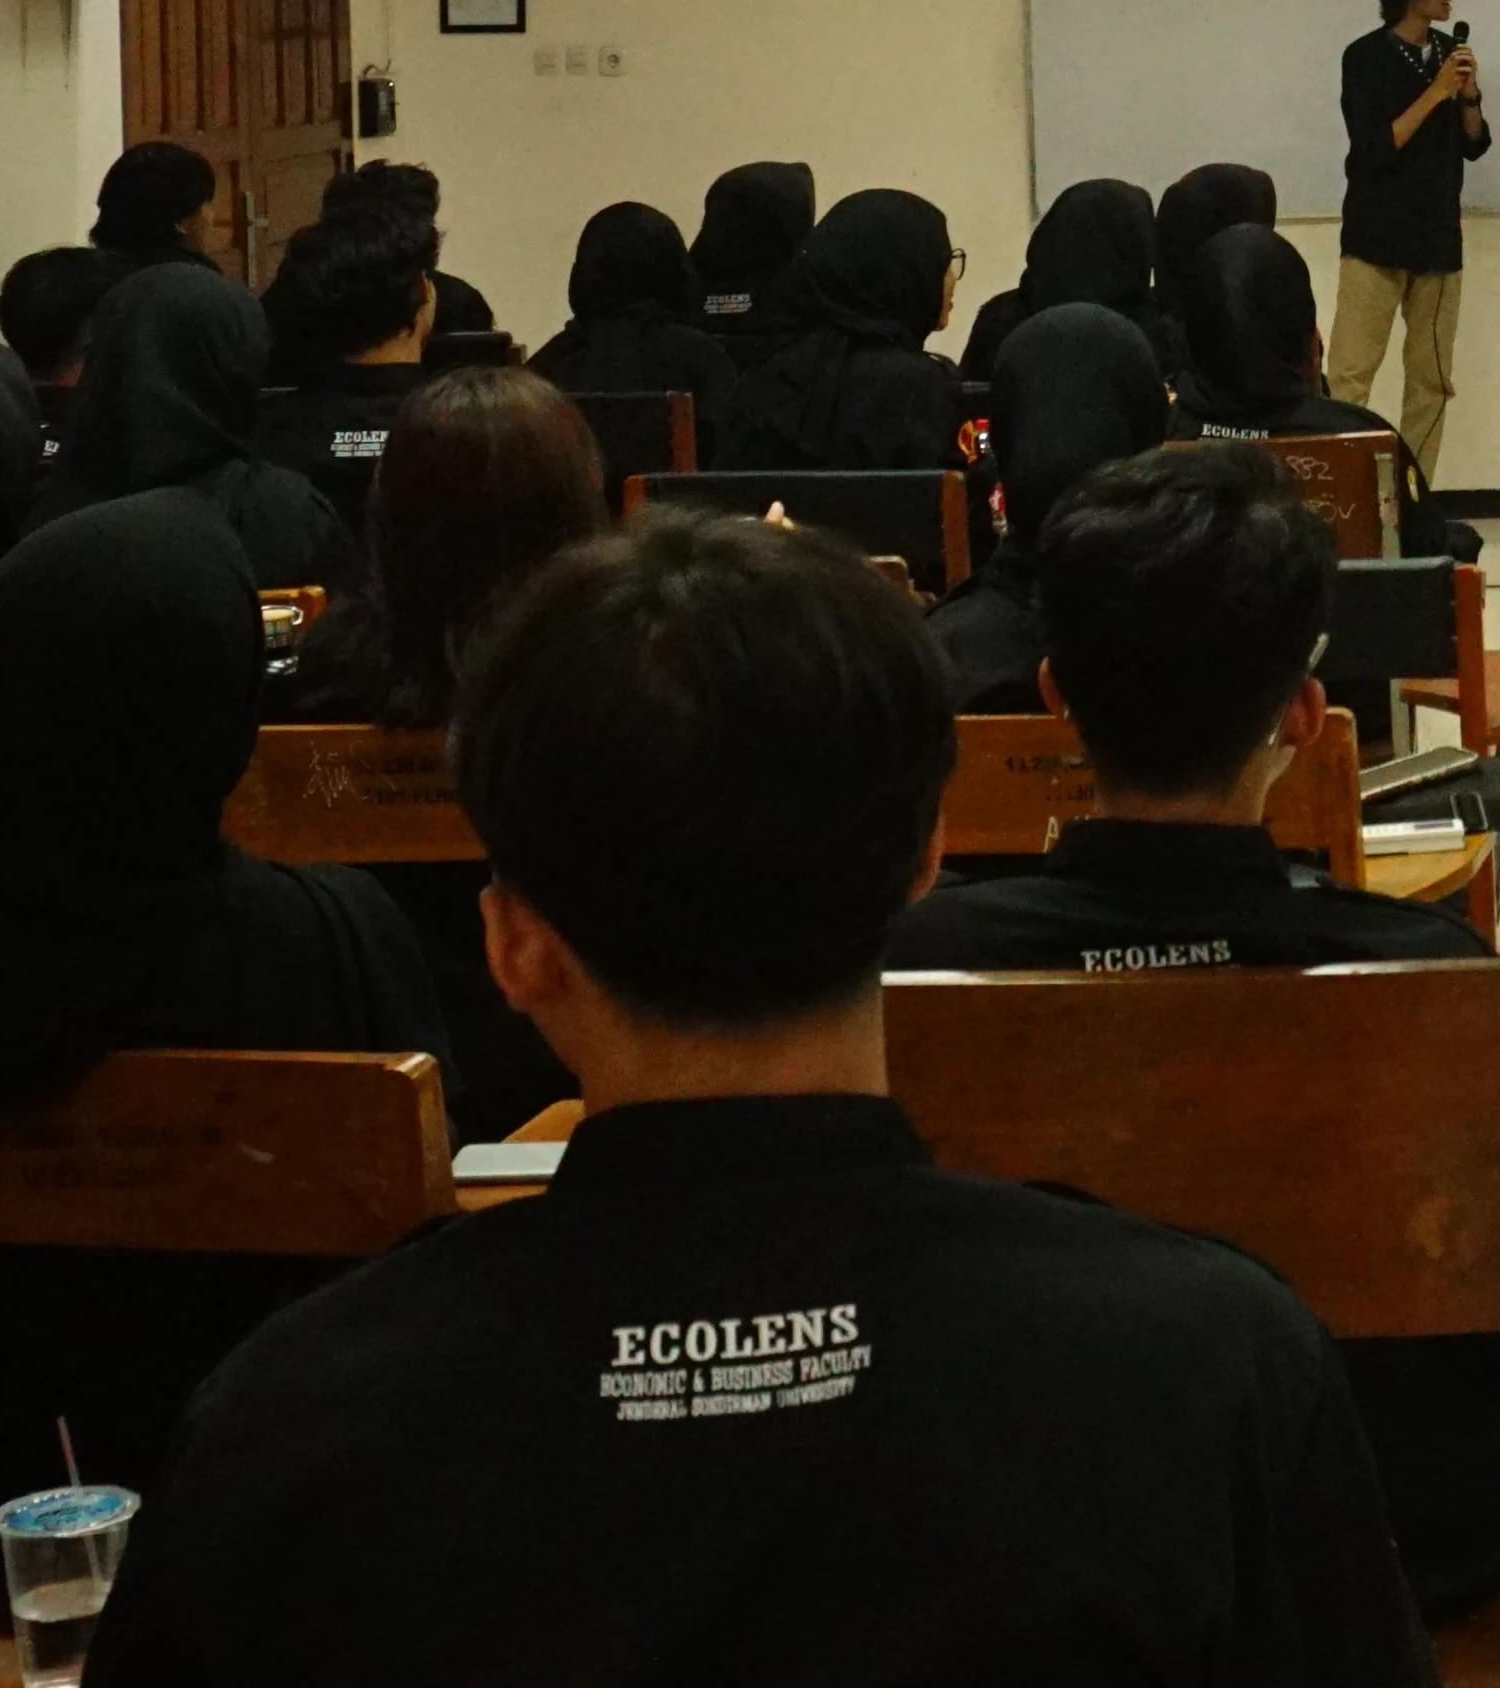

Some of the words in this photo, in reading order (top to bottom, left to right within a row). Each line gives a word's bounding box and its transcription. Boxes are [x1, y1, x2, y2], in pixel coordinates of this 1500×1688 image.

[332, 430, 390, 443] ECOLEN
[1201, 423, 1269, 440] ECOLENS
[1080, 939, 1232, 973] ECOLENS
[611, 1304, 859, 1367] ECOLENS
[600, 1367, 688, 1399] ECONOMIC
[711, 1360, 794, 1392] BUSINESS
[799, 1345, 871, 1383] FACULTY
